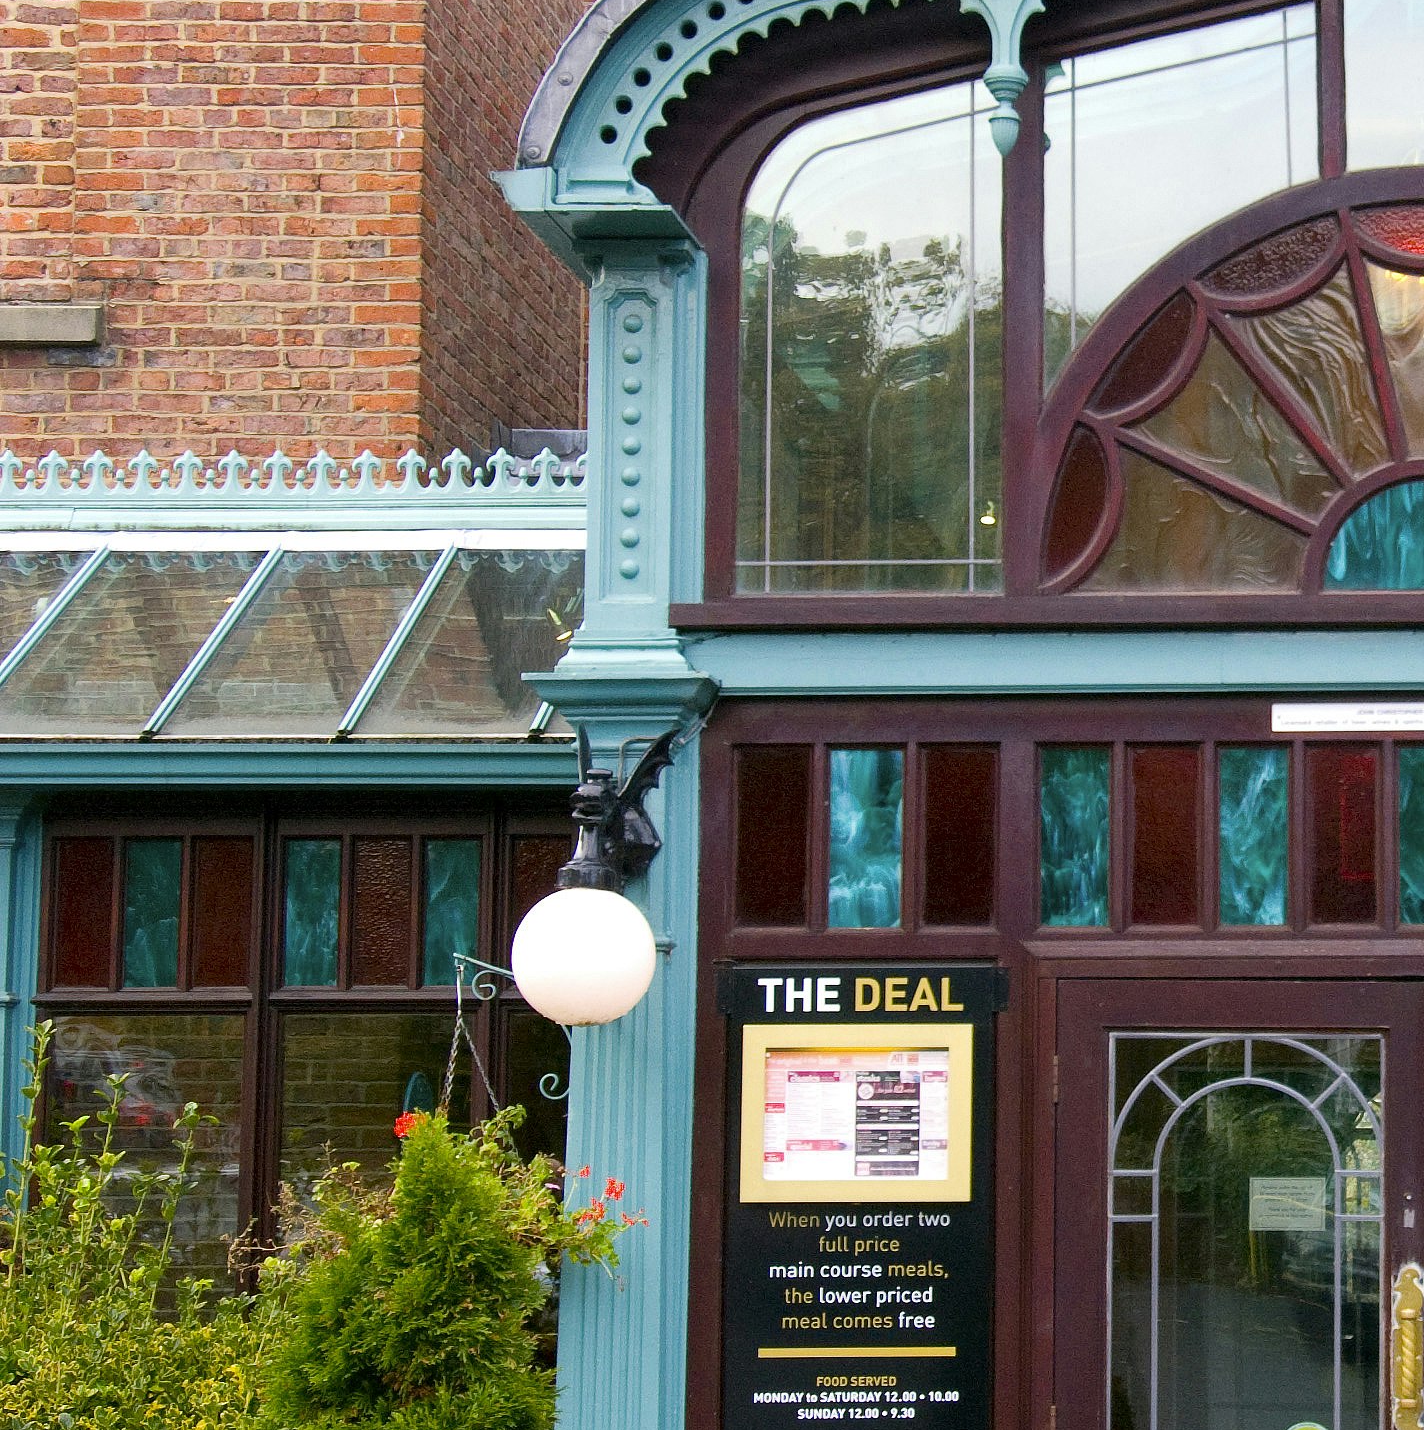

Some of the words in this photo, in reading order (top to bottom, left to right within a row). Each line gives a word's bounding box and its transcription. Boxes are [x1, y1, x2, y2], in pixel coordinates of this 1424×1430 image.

[758, 977, 841, 1012] THE
[855, 978, 964, 1011] DEAL
[769, 1212, 819, 1227] When
[825, 1216, 856, 1231] you
[863, 1211, 913, 1226] order
[919, 1212, 950, 1226] two
[819, 1236, 849, 1252] full
[855, 1236, 899, 1256] price
[770, 1261, 814, 1278] main
[820, 1265, 882, 1277] course
[888, 1261, 948, 1278] meals,
[785, 1288, 813, 1303] the
[820, 1287, 871, 1303] lower
[876, 1287, 933, 1307] priced
[782, 1313, 827, 1329] meal
[833, 1317, 892, 1328] comes
[898, 1312, 935, 1328] free
[817, 1377, 847, 1386] FOOD
[850, 1376, 896, 1386] SERVED
[754, 1392, 804, 1403] MONDAY
[806, 1393, 818, 1403] to
[820, 1392, 882, 1402] SATURDAY
[884, 1391, 916, 1402] 12.00
[928, 1391, 959, 1402] 10.00
[797, 1408, 846, 1419] SUNDAY
[849, 1408, 879, 1418] 12.00
[891, 1408, 915, 1418] 9.30
